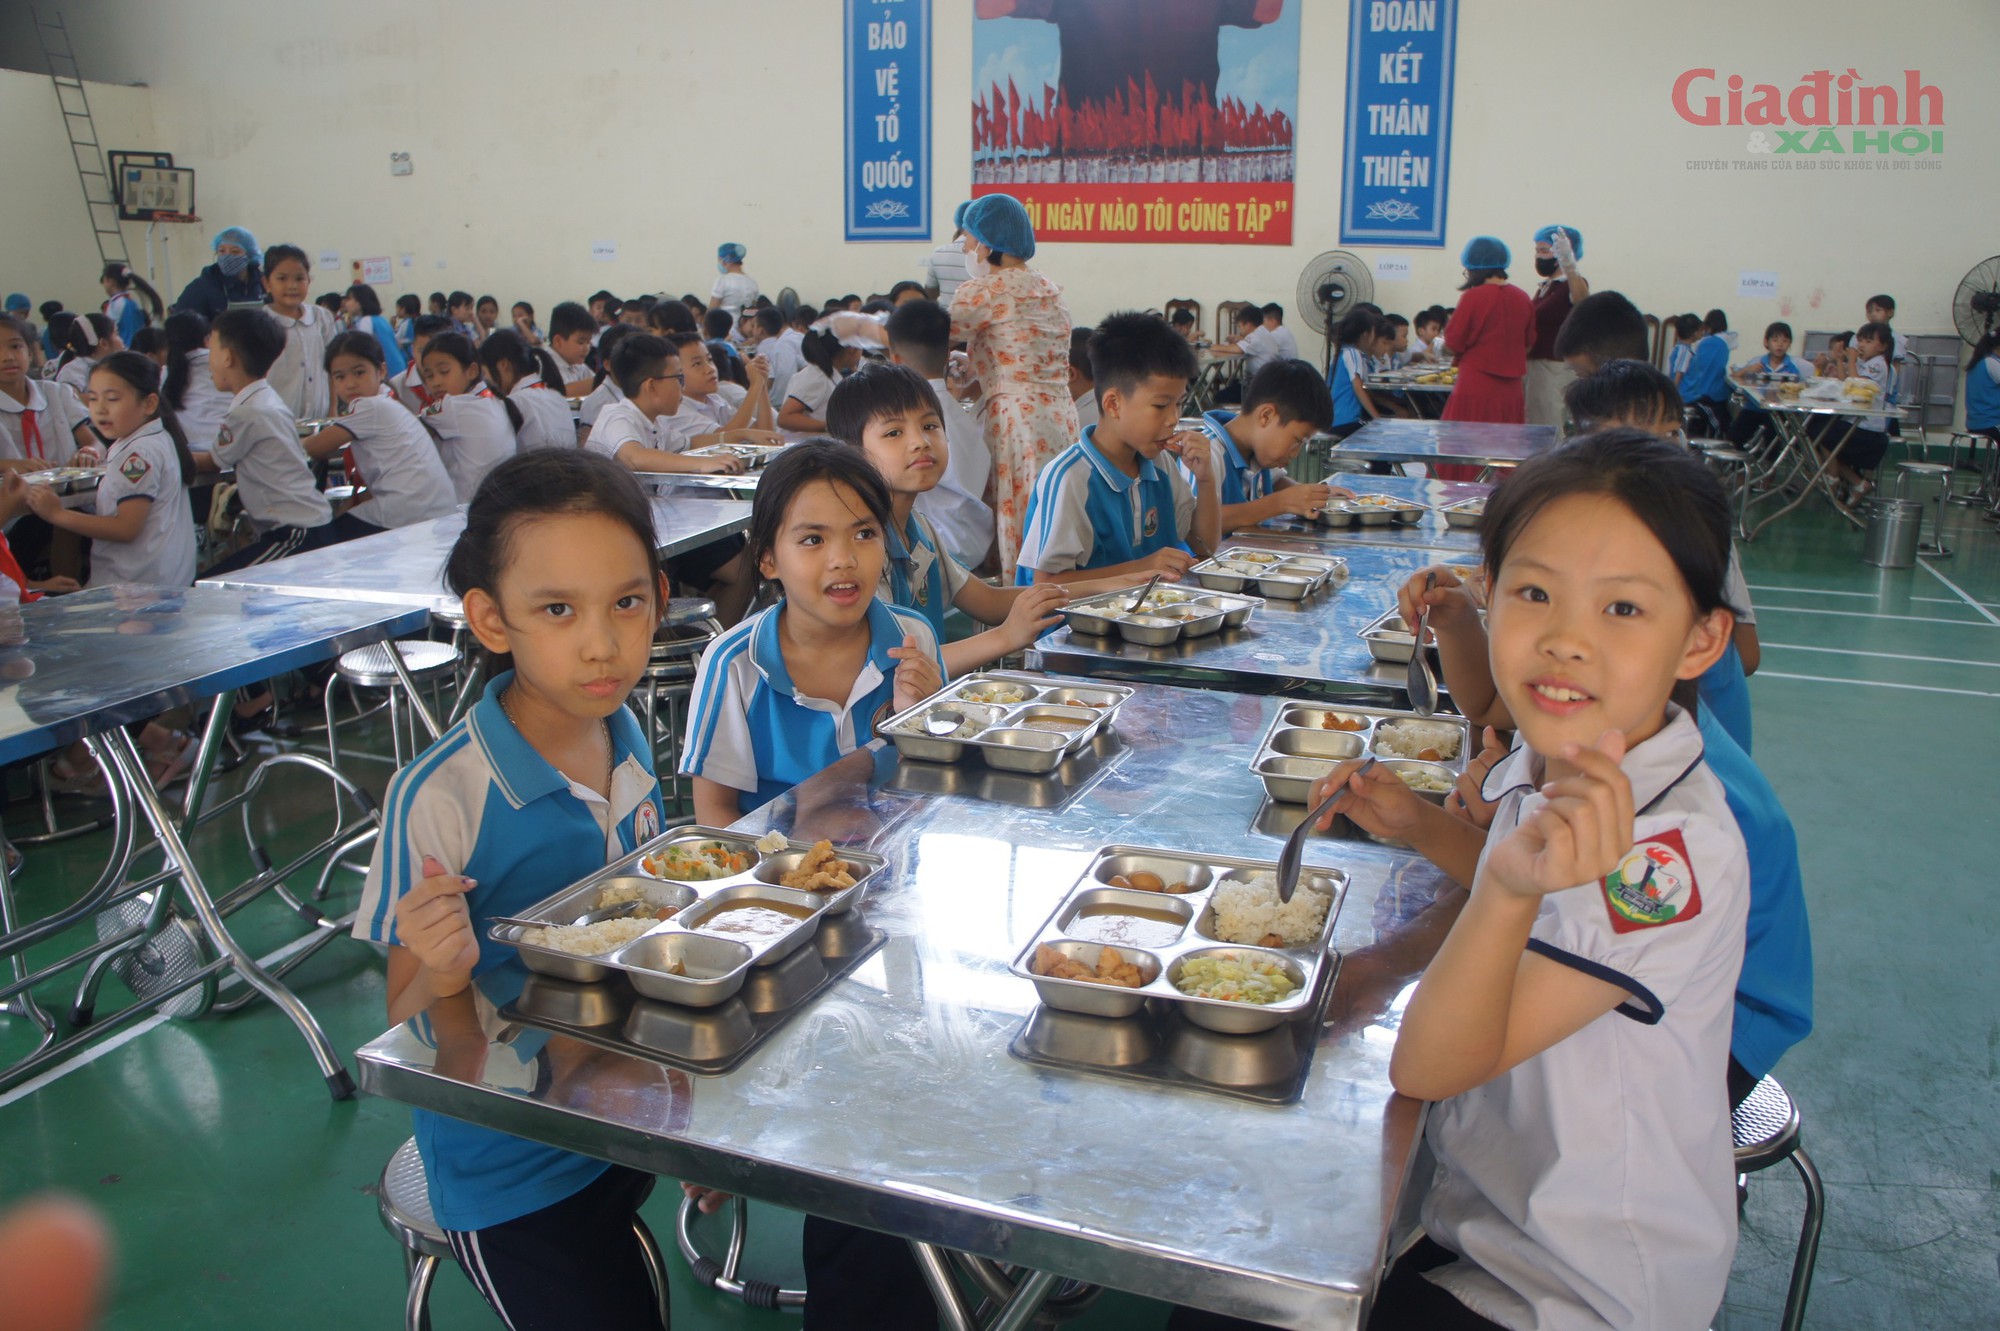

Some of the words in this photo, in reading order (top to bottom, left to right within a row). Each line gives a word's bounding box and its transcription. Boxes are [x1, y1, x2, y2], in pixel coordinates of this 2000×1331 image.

[868, 9, 907, 51] BẢO
[875, 62, 899, 102] VỆ
[1379, 41, 1423, 84] KẾT
[875, 103, 900, 143] TỔ
[1368, 98, 1429, 136] THÂN
[862, 150, 914, 192] QUỐC
[1362, 150, 1430, 194] THIỆN
[1047, 197, 1095, 231] NGÀY
[1101, 197, 1138, 231] NÀO
[1144, 197, 1173, 231] TÔI
[1178, 197, 1230, 232] CŨNG
